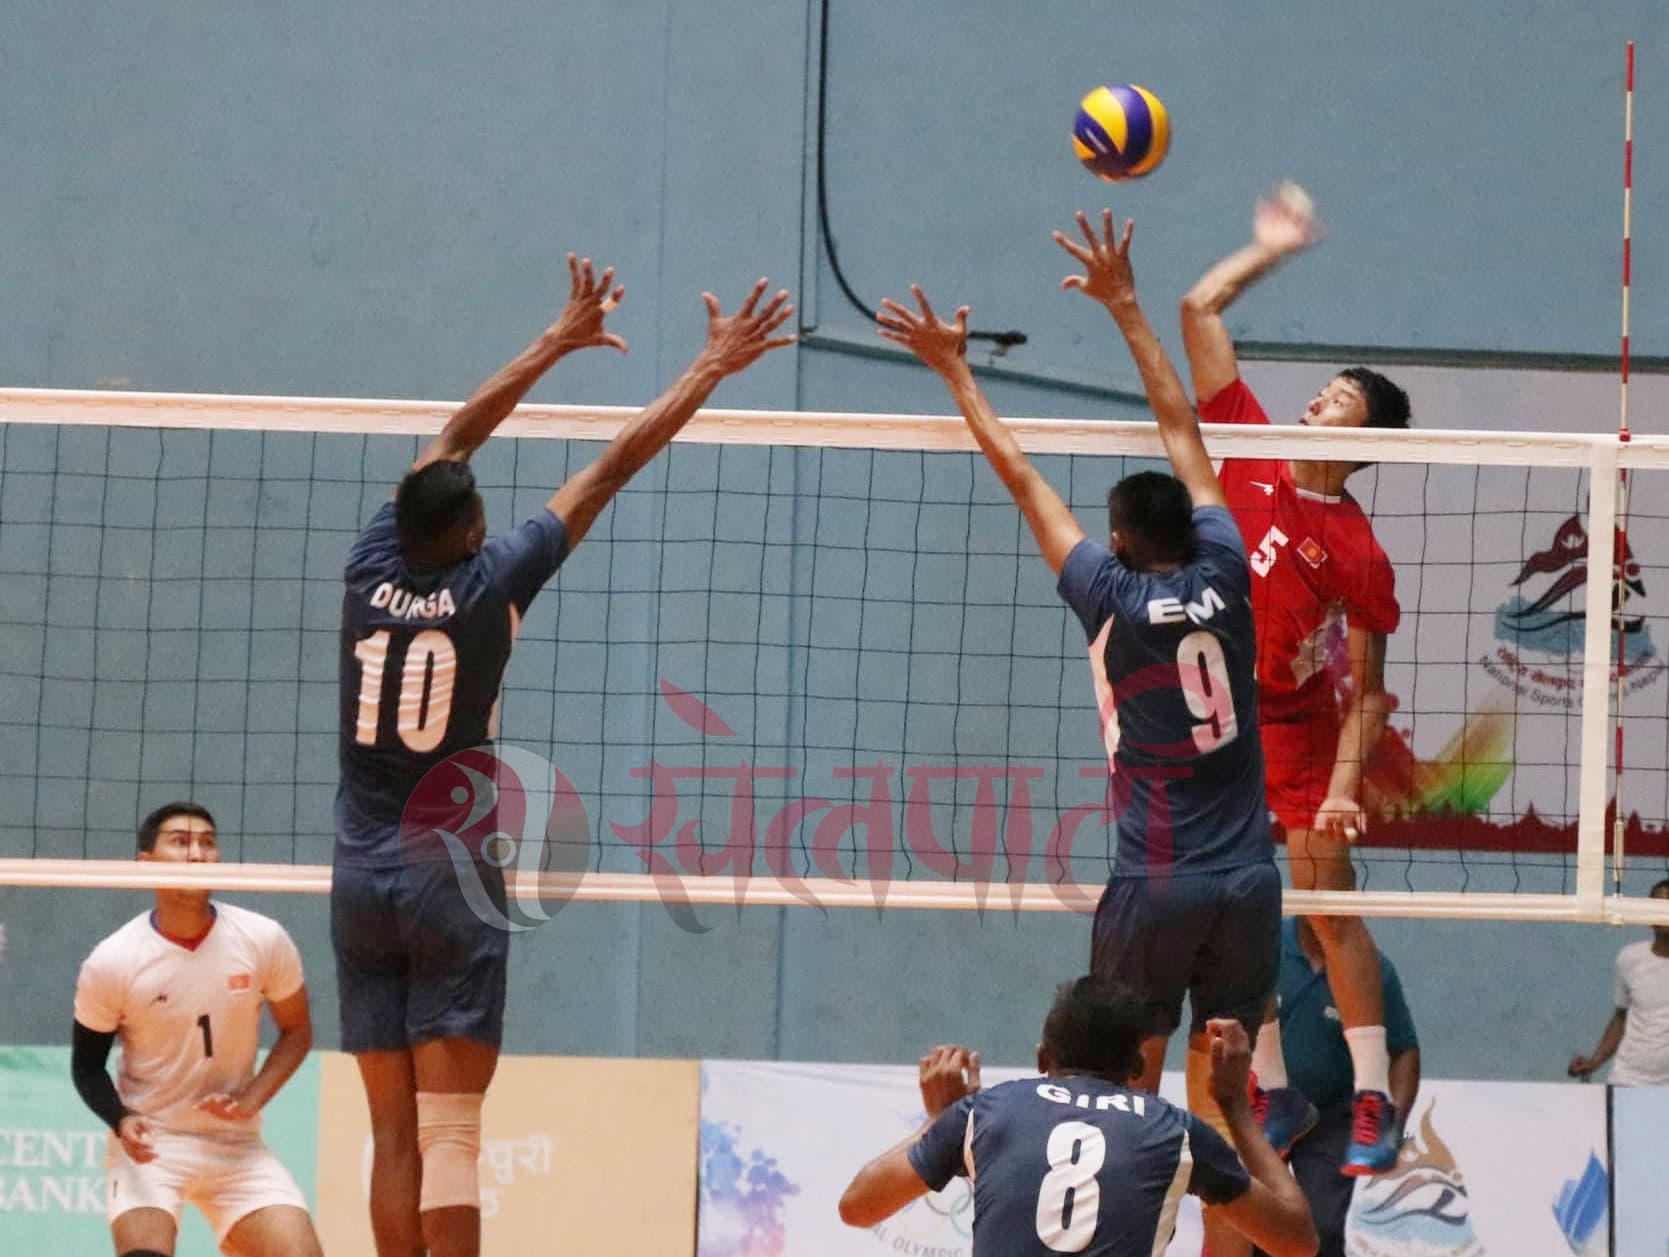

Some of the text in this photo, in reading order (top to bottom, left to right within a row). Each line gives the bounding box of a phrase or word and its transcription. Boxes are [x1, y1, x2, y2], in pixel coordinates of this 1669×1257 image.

[1250, 525, 1289, 578] 5
[370, 582, 456, 620] DURGA
[1147, 587, 1226, 624] EM
[354, 629, 457, 752] 10
[1177, 630, 1238, 754] 9
[197, 1013, 213, 1058] 1
[1036, 1083, 1145, 1117] GIRI
[482, 1132, 554, 1184] पुरी
[0, 1175, 106, 1213] ANK
[1036, 1121, 1106, 1253] 8
